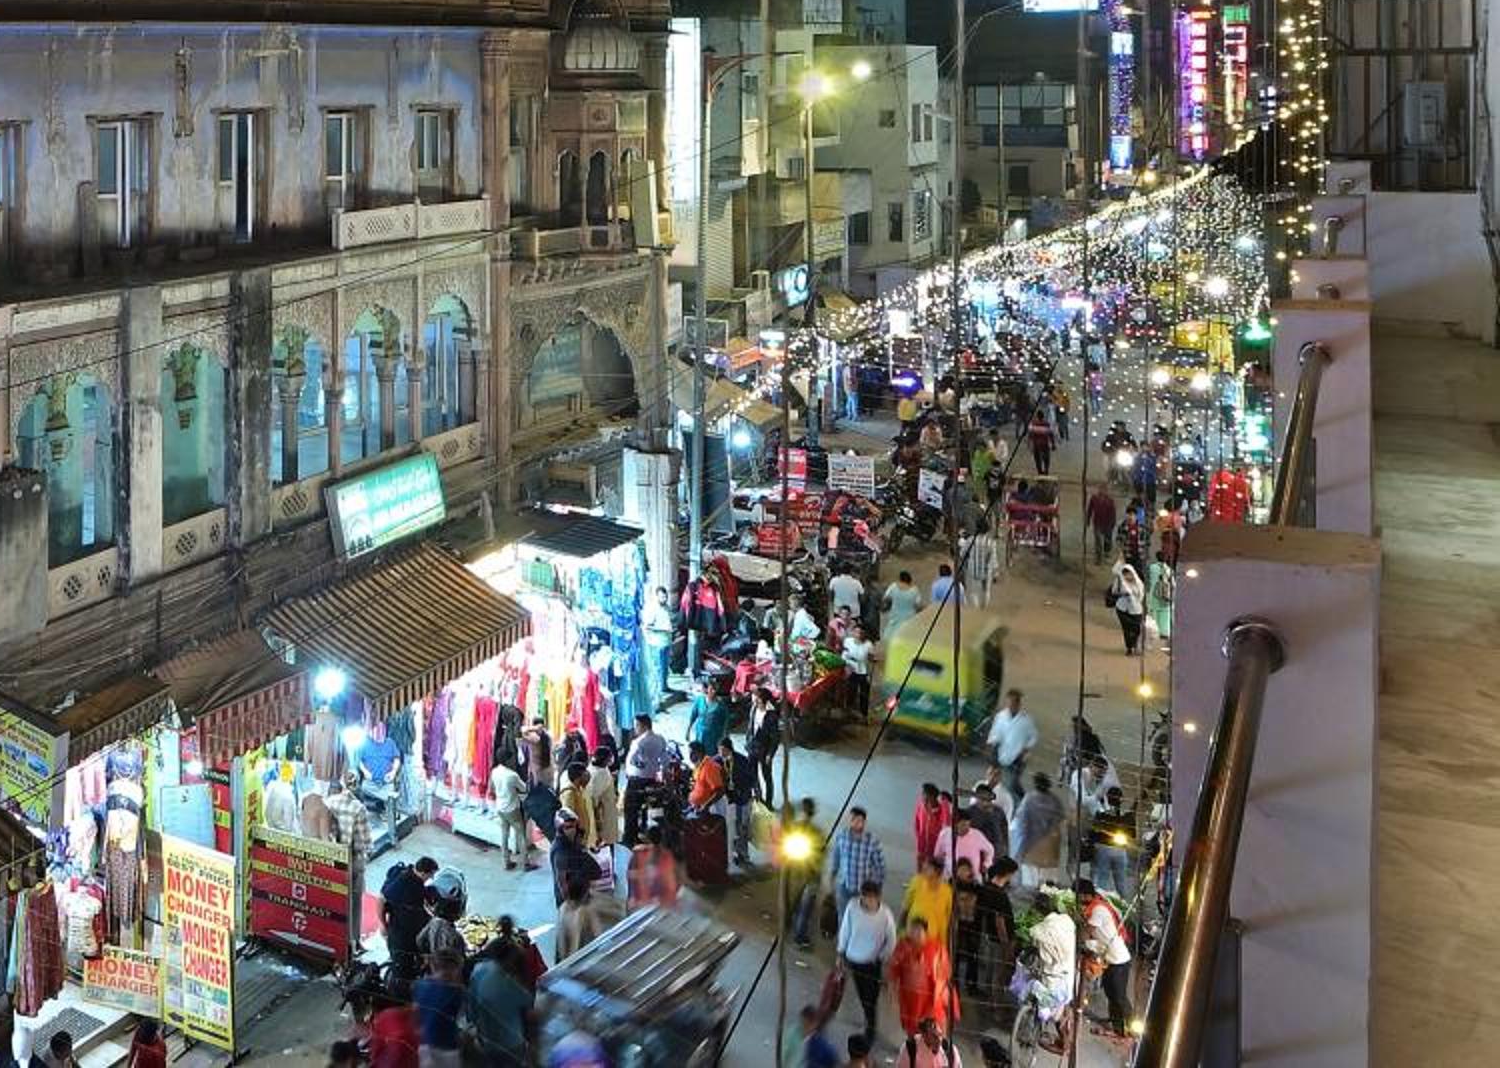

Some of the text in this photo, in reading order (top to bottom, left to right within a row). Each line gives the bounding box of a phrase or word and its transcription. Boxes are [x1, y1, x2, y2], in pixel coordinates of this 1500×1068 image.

[167, 867, 231, 911] MONEY
[167, 893, 231, 931] CHANGER
[182, 918, 226, 956] MONEY
[88, 958, 160, 983] MONEY
[124, 951, 159, 966] PRICE
[183, 945, 229, 989] CHANGER
[88, 972, 159, 997] CHANGER
